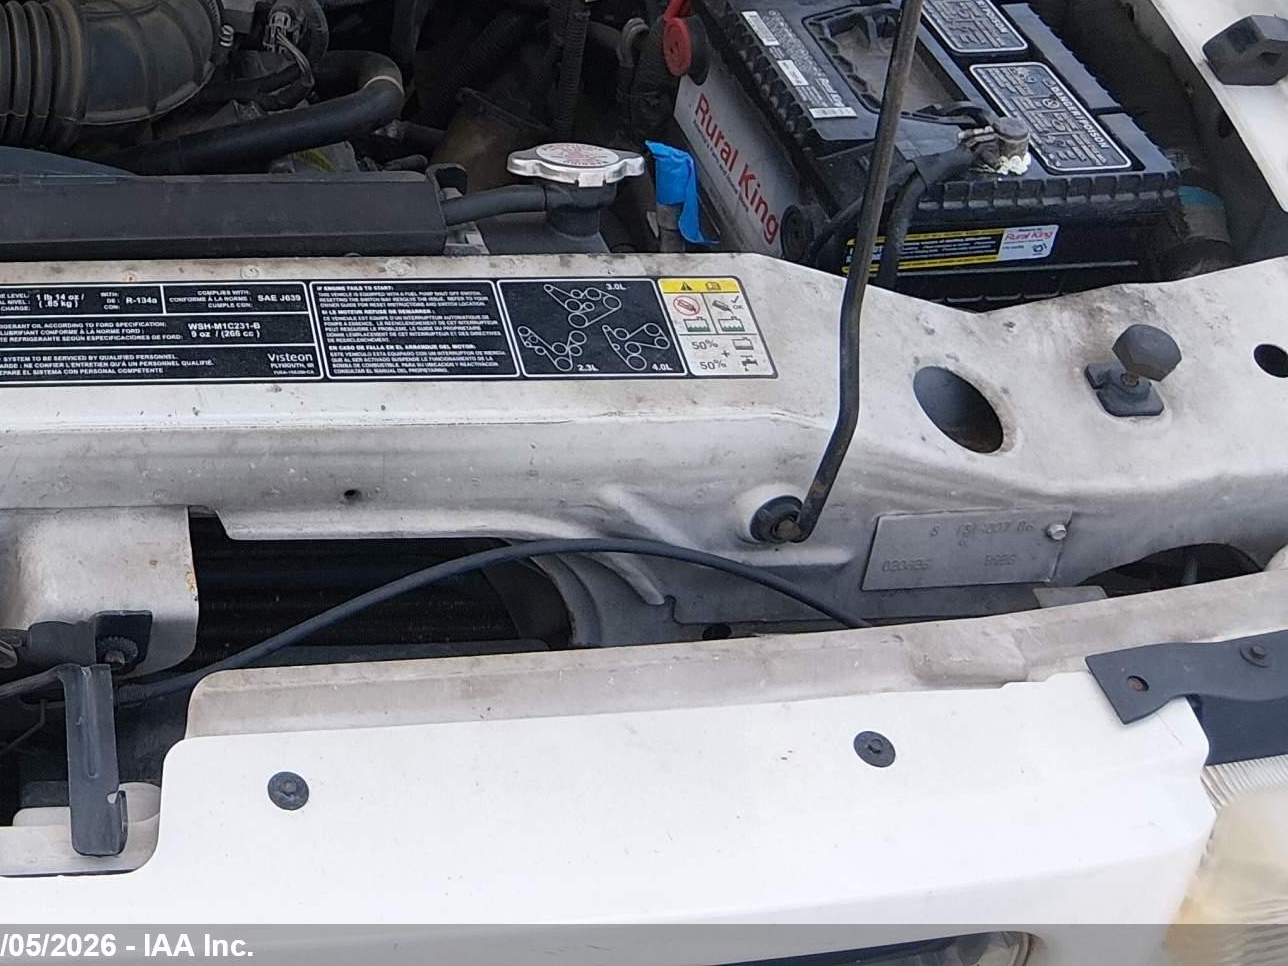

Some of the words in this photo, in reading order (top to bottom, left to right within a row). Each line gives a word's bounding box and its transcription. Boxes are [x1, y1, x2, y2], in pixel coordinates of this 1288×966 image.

[1053, 85, 1110, 150] DANGER/POISON
[694, 92, 738, 172] Rural
[738, 163, 780, 245] King
[44, 300, 59, 308] .85
[59, 300, 73, 308] kg
[187, 322, 261, 330] WSH-M1C231-B
[692, 339, 718, 350] 50%
[267, 352, 313, 362] Visteon
[700, 359, 727, 370] 50%
